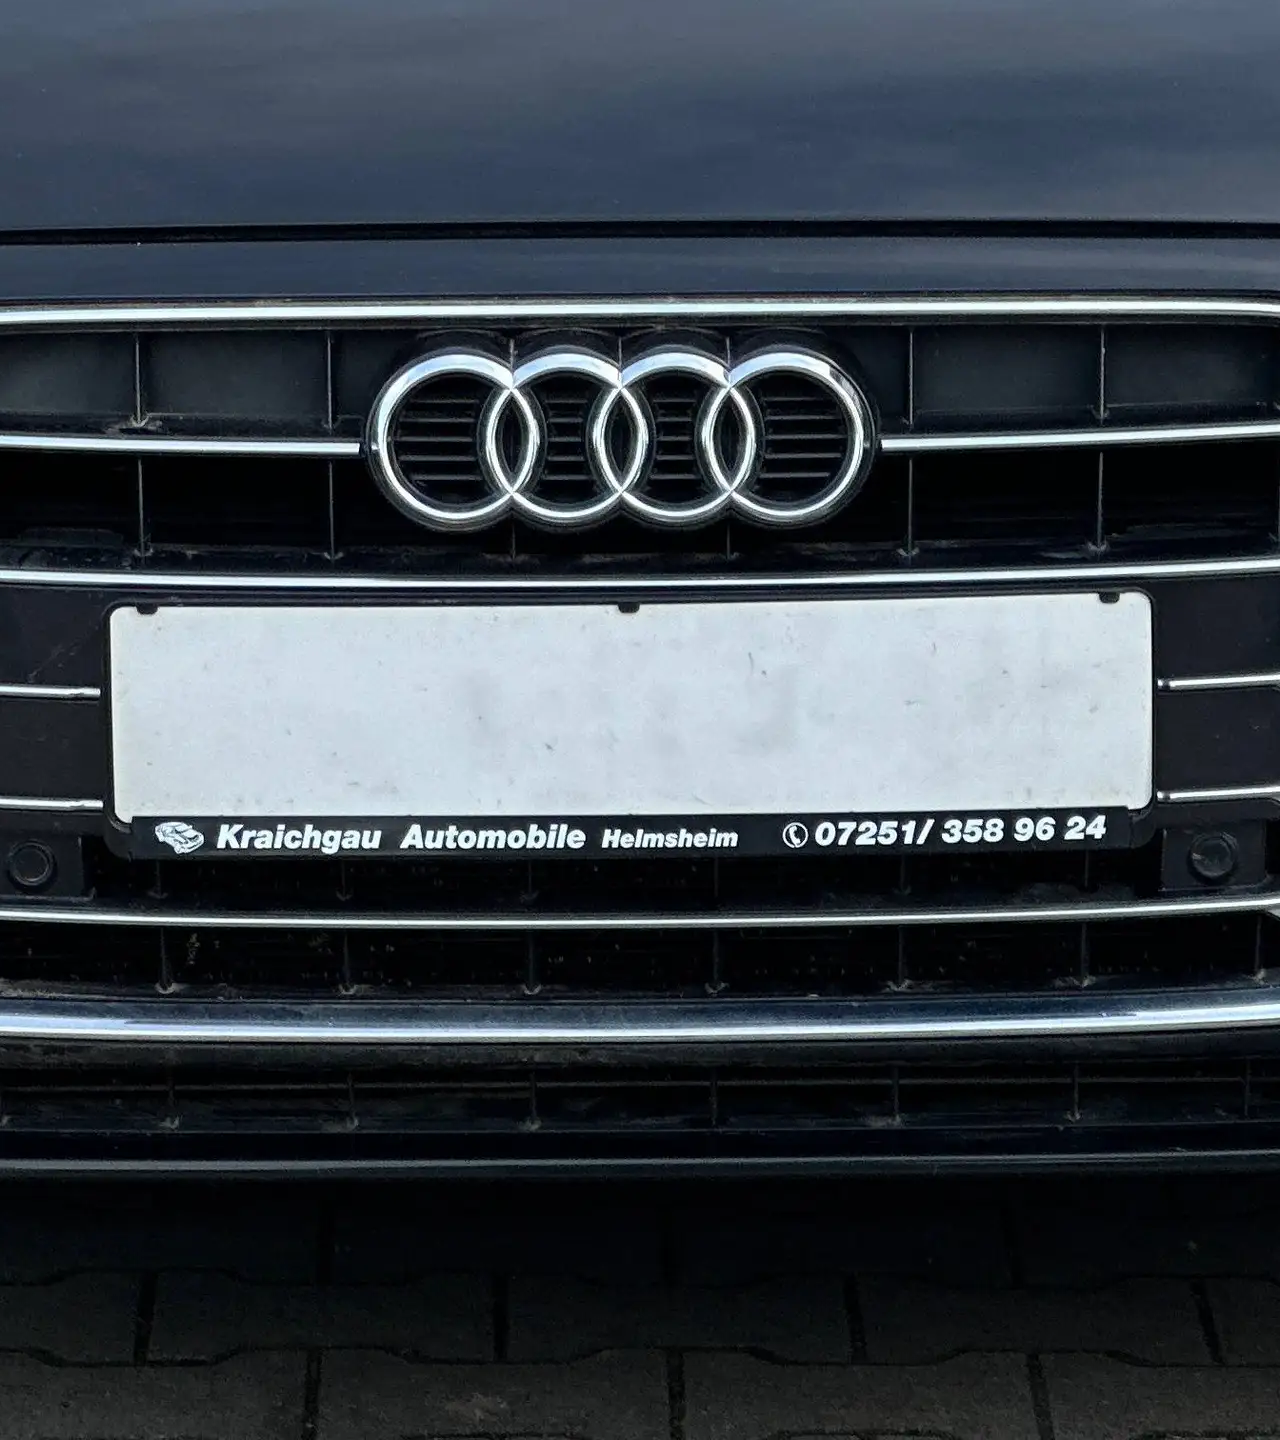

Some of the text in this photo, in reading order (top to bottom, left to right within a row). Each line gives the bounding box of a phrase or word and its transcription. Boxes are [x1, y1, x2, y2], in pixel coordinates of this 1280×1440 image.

[216, 815, 1107, 855] Kraichgau Automobile Helmsheim 07251/ 358 96 24
